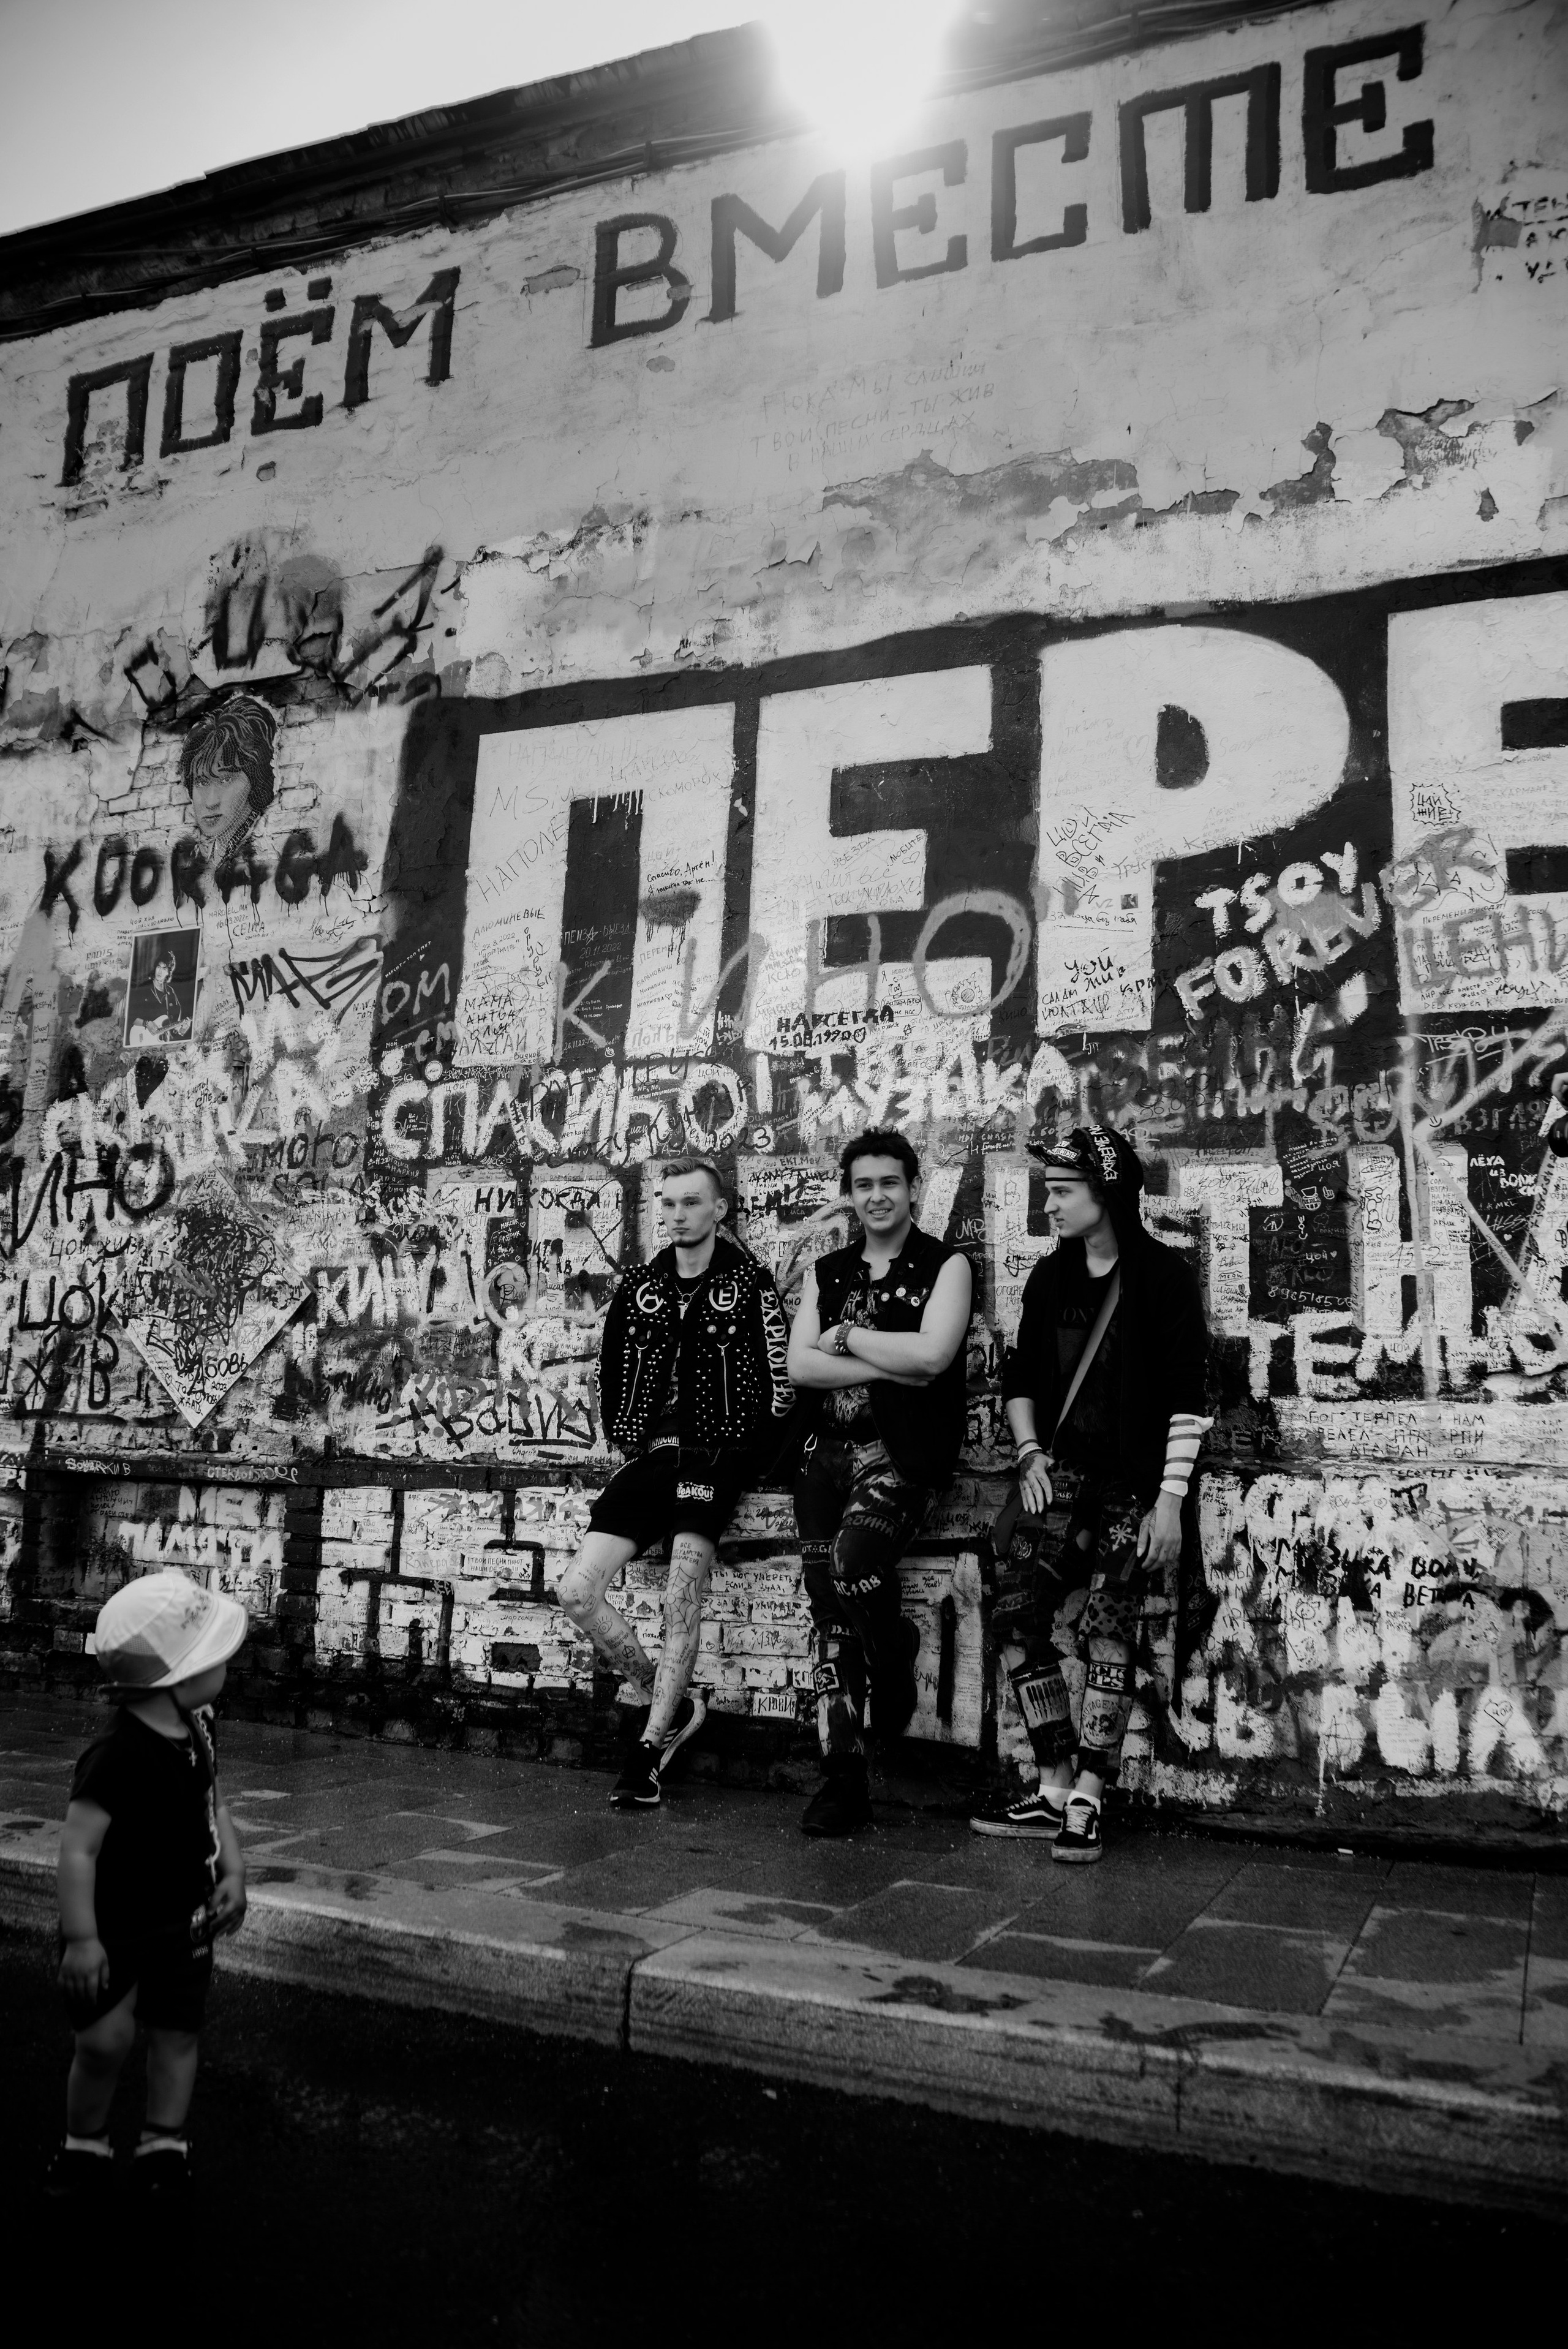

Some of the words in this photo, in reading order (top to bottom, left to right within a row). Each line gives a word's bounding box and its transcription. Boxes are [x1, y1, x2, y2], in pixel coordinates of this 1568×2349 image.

[61, 268, 461, 488] ПОЁМ
[590, 23, 1434, 349] ВМЕСТЕ
[636, 964, 673, 987] БАРАНОВИЧИ
